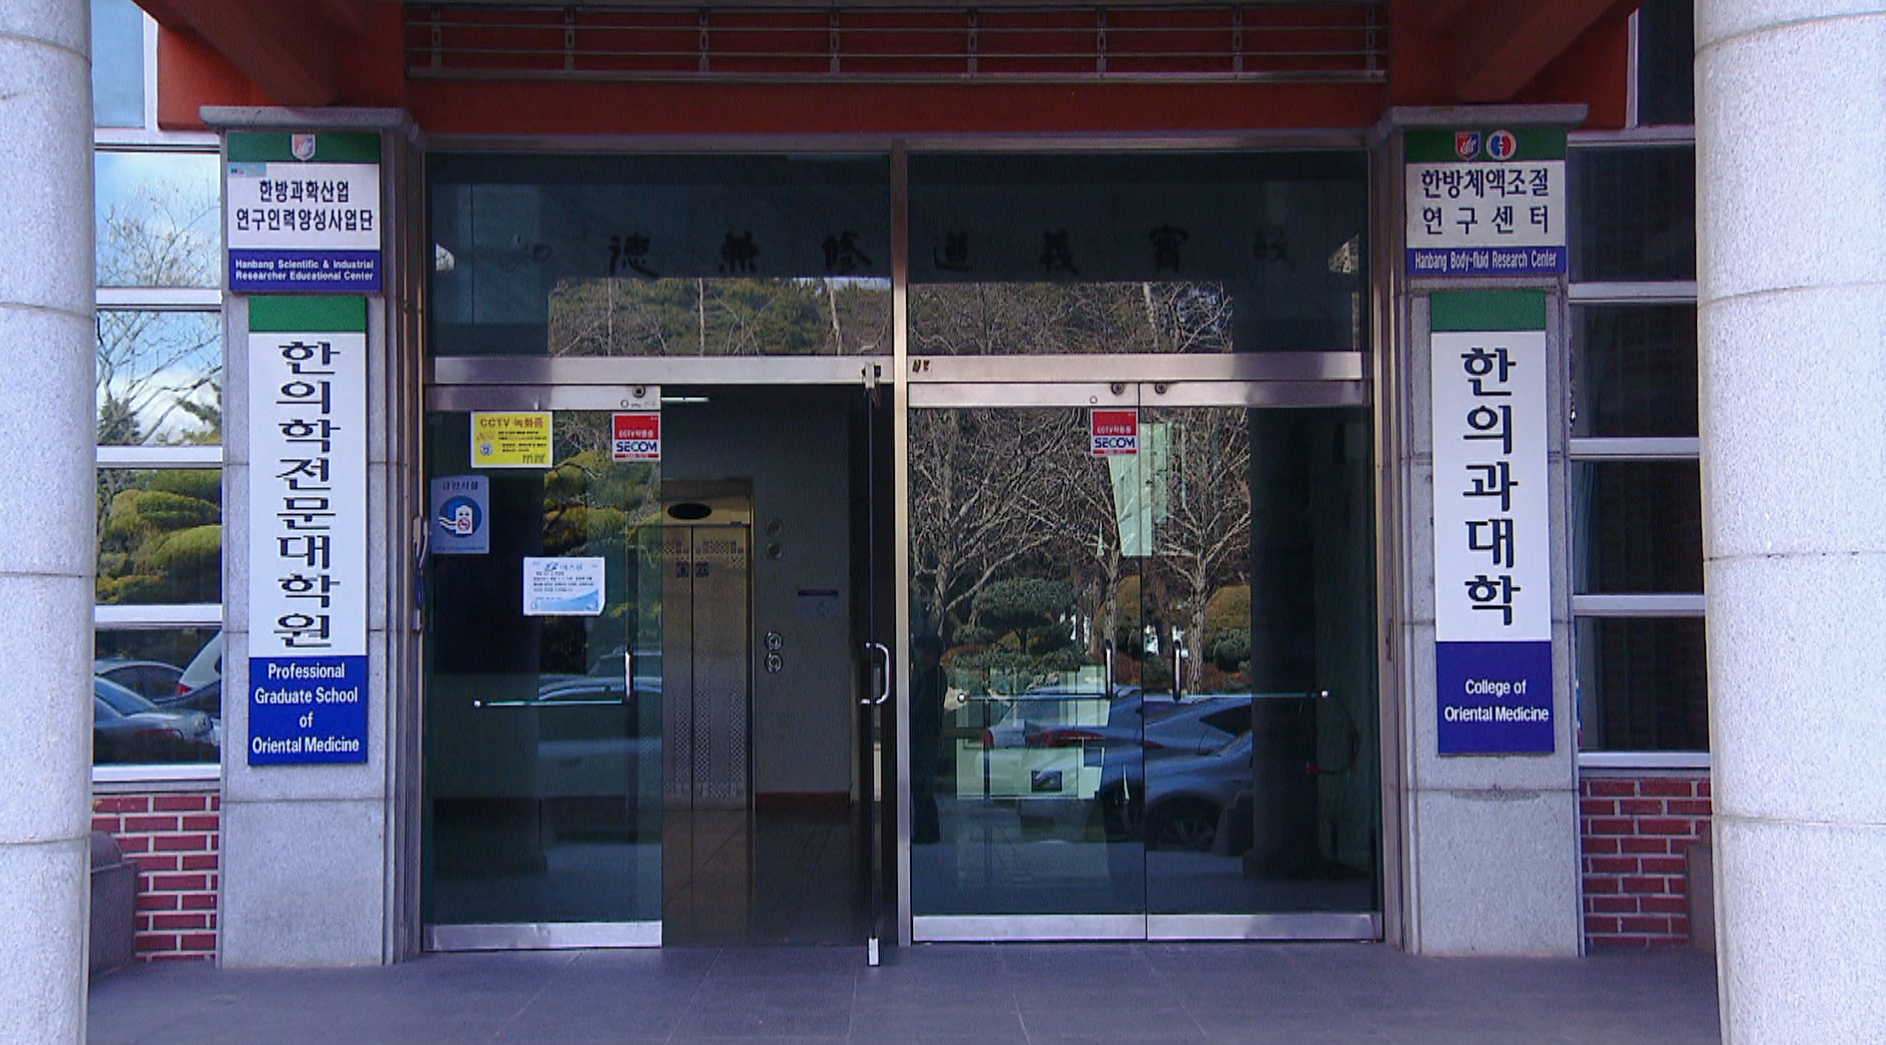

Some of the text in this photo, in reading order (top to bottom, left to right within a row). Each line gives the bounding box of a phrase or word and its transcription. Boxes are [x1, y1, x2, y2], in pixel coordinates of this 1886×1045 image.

[259, 180, 350, 203] 한방과학산업
[1421, 168, 1549, 198] 한방체액조절
[236, 209, 374, 232] 연구인력양성사업단
[236, 259, 374, 270] Hanbang Scientific & Industrial
[1415, 250, 1557, 272] Hanbang Body-fluid Research Center
[236, 271, 374, 280] Researcher Educational Center
[480, 417, 511, 428] CCTV
[616, 441, 658, 452] SECOM
[1095, 437, 1135, 448] SECOM
[273, 341, 341, 648] 한의학전문대학원
[1460, 347, 1521, 626] 한의과대학
[268, 662, 345, 680] Professional
[255, 686, 358, 704] Graduate School
[1465, 679, 1527, 698] College of
[299, 712, 313, 728] of
[1444, 705, 1549, 722] Oriental Medicine
[252, 736, 359, 754] Oriental Medicine
